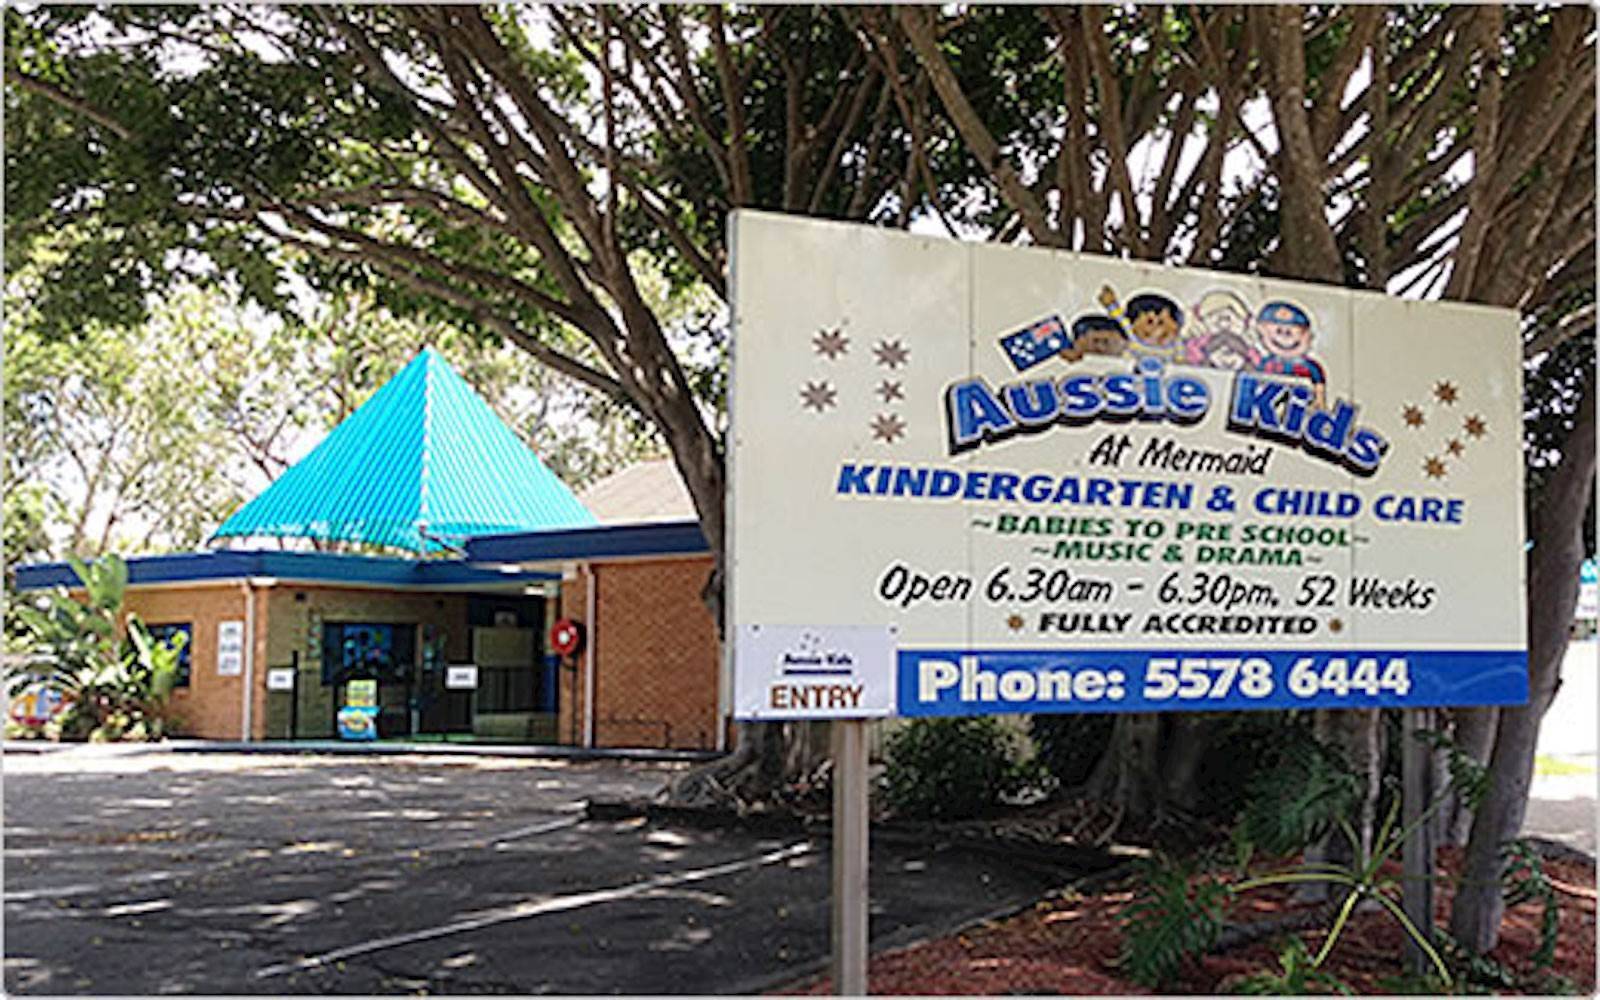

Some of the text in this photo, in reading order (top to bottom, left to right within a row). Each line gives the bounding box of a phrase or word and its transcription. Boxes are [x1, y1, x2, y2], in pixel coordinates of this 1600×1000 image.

[949, 358, 1389, 477] Aussie Kids
[1090, 434, 1273, 475] At Mermaid
[837, 465, 1465, 523] KINDERGARTEN & CHILD CARE
[1125, 518, 1165, 538] TO
[1176, 521, 1232, 542] PRE
[1162, 544, 1183, 563] &
[879, 565, 972, 608] Open
[986, 567, 1113, 602] 6.30am
[1295, 576, 1337, 607] 52
[1350, 577, 1436, 610] Weeks
[1038, 613, 1318, 635] FULLY ACCREDITED
[770, 684, 864, 709] ENTRY
[918, 656, 1412, 702] Phone: 5578 6444
